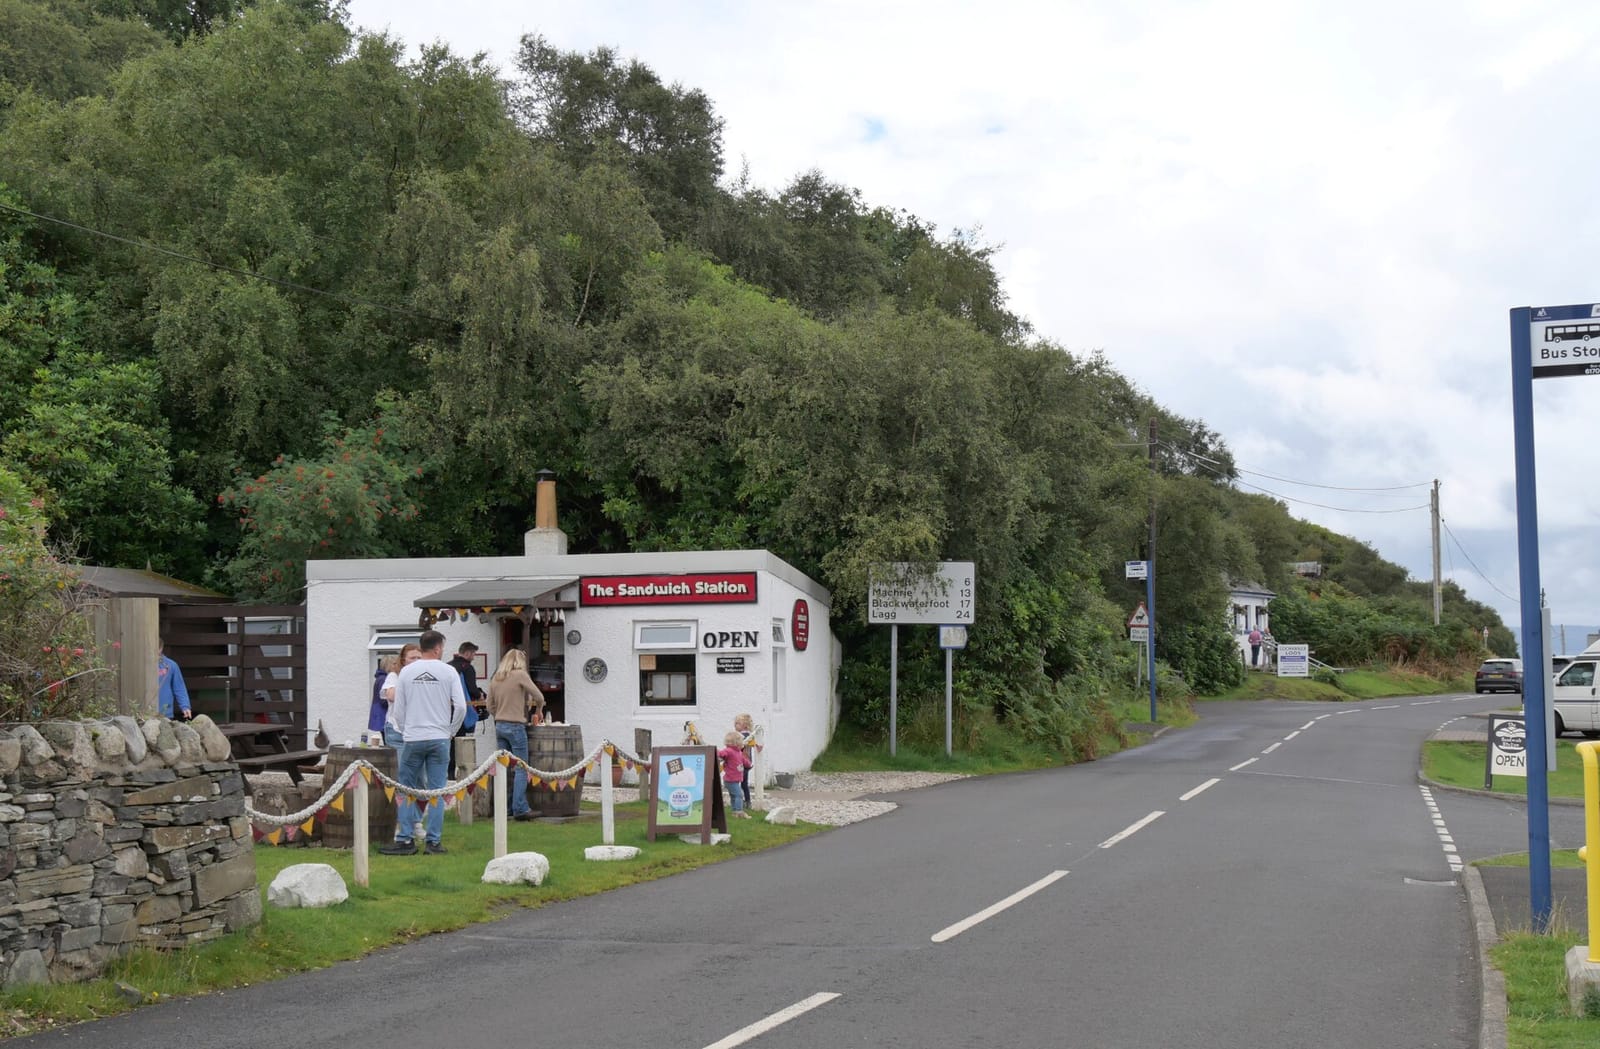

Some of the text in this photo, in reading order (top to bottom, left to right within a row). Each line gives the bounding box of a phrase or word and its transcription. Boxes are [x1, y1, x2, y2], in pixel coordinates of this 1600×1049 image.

[1541, 348, 1568, 359] Bus
[964, 577, 971, 586] 6
[587, 581, 747, 597] The Sandwich Station
[960, 589, 971, 598] 13
[872, 599, 971, 609] Blackwaterfoot 17
[872, 610, 970, 620] Lagg 24
[703, 631, 760, 649] OPEN
[1496, 755, 1524, 767] OPEN
